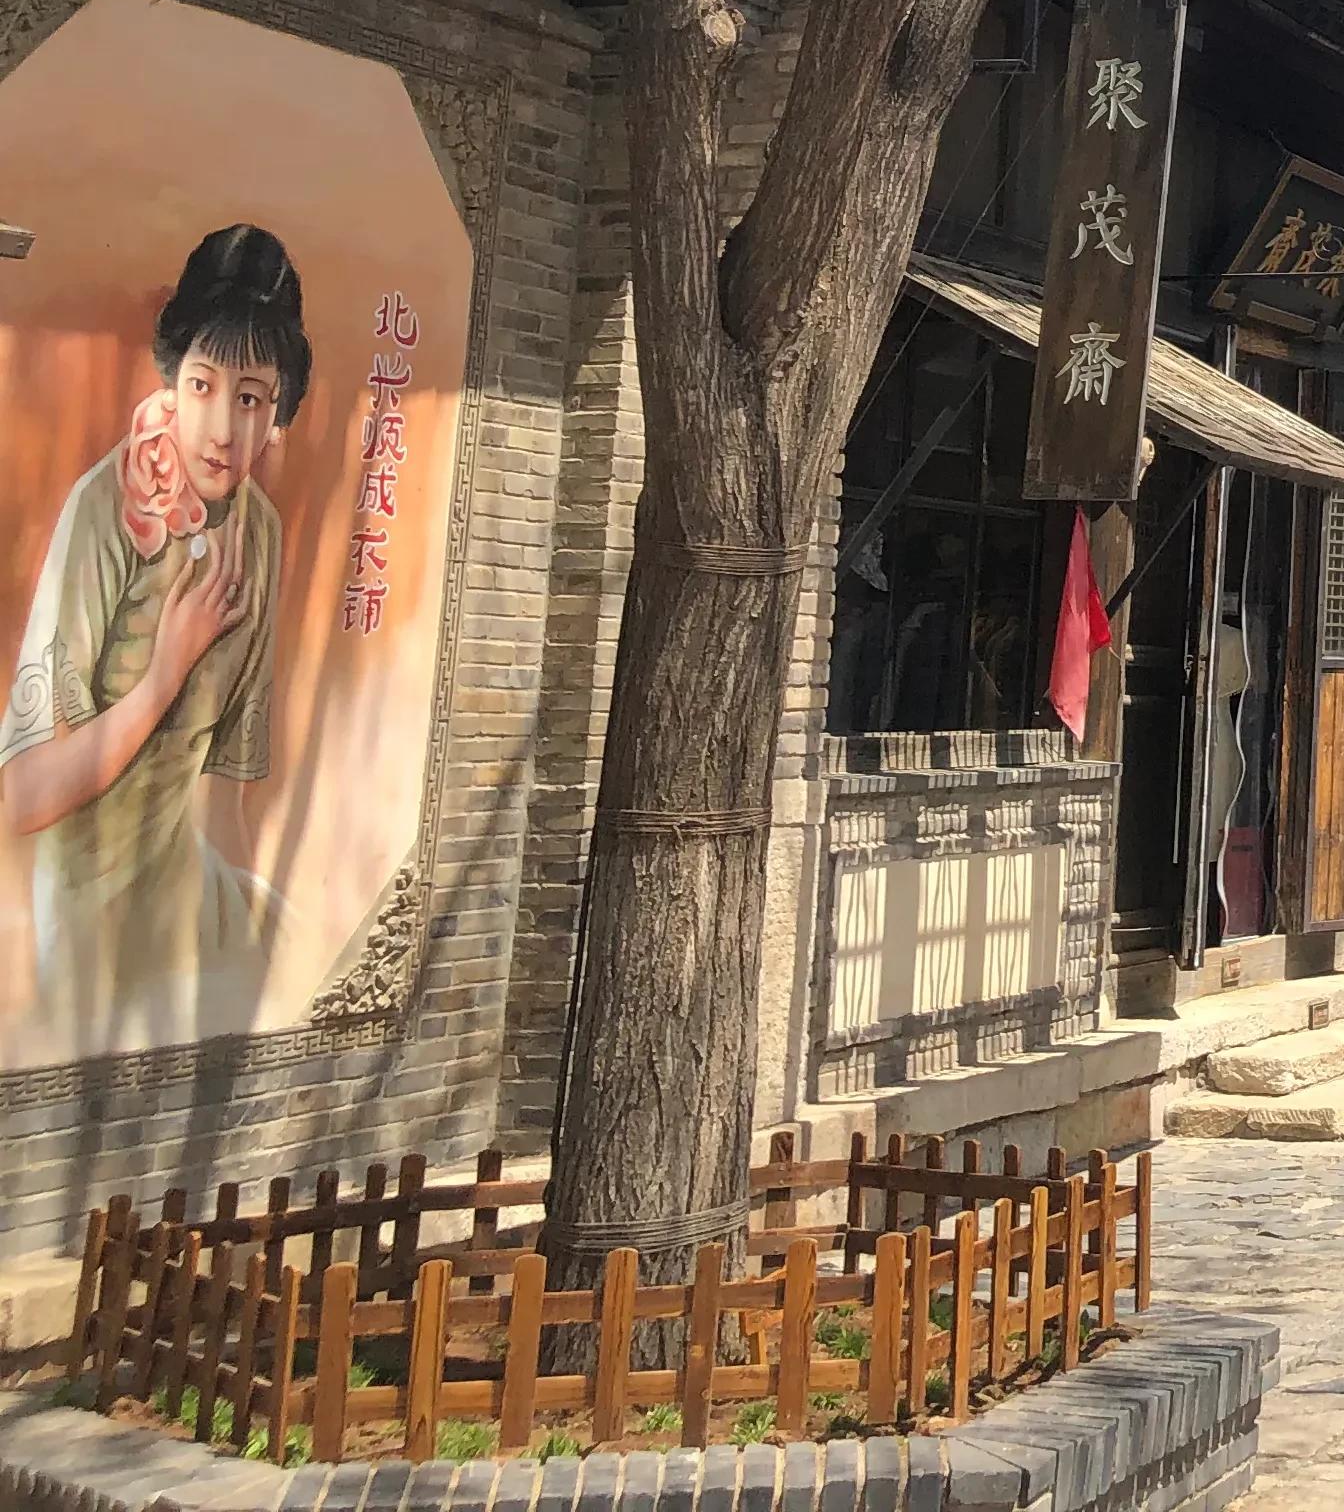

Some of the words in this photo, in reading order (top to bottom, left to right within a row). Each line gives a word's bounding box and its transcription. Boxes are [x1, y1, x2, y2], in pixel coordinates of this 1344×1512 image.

[342, 289, 420, 636] 北兴顺成衣铺
